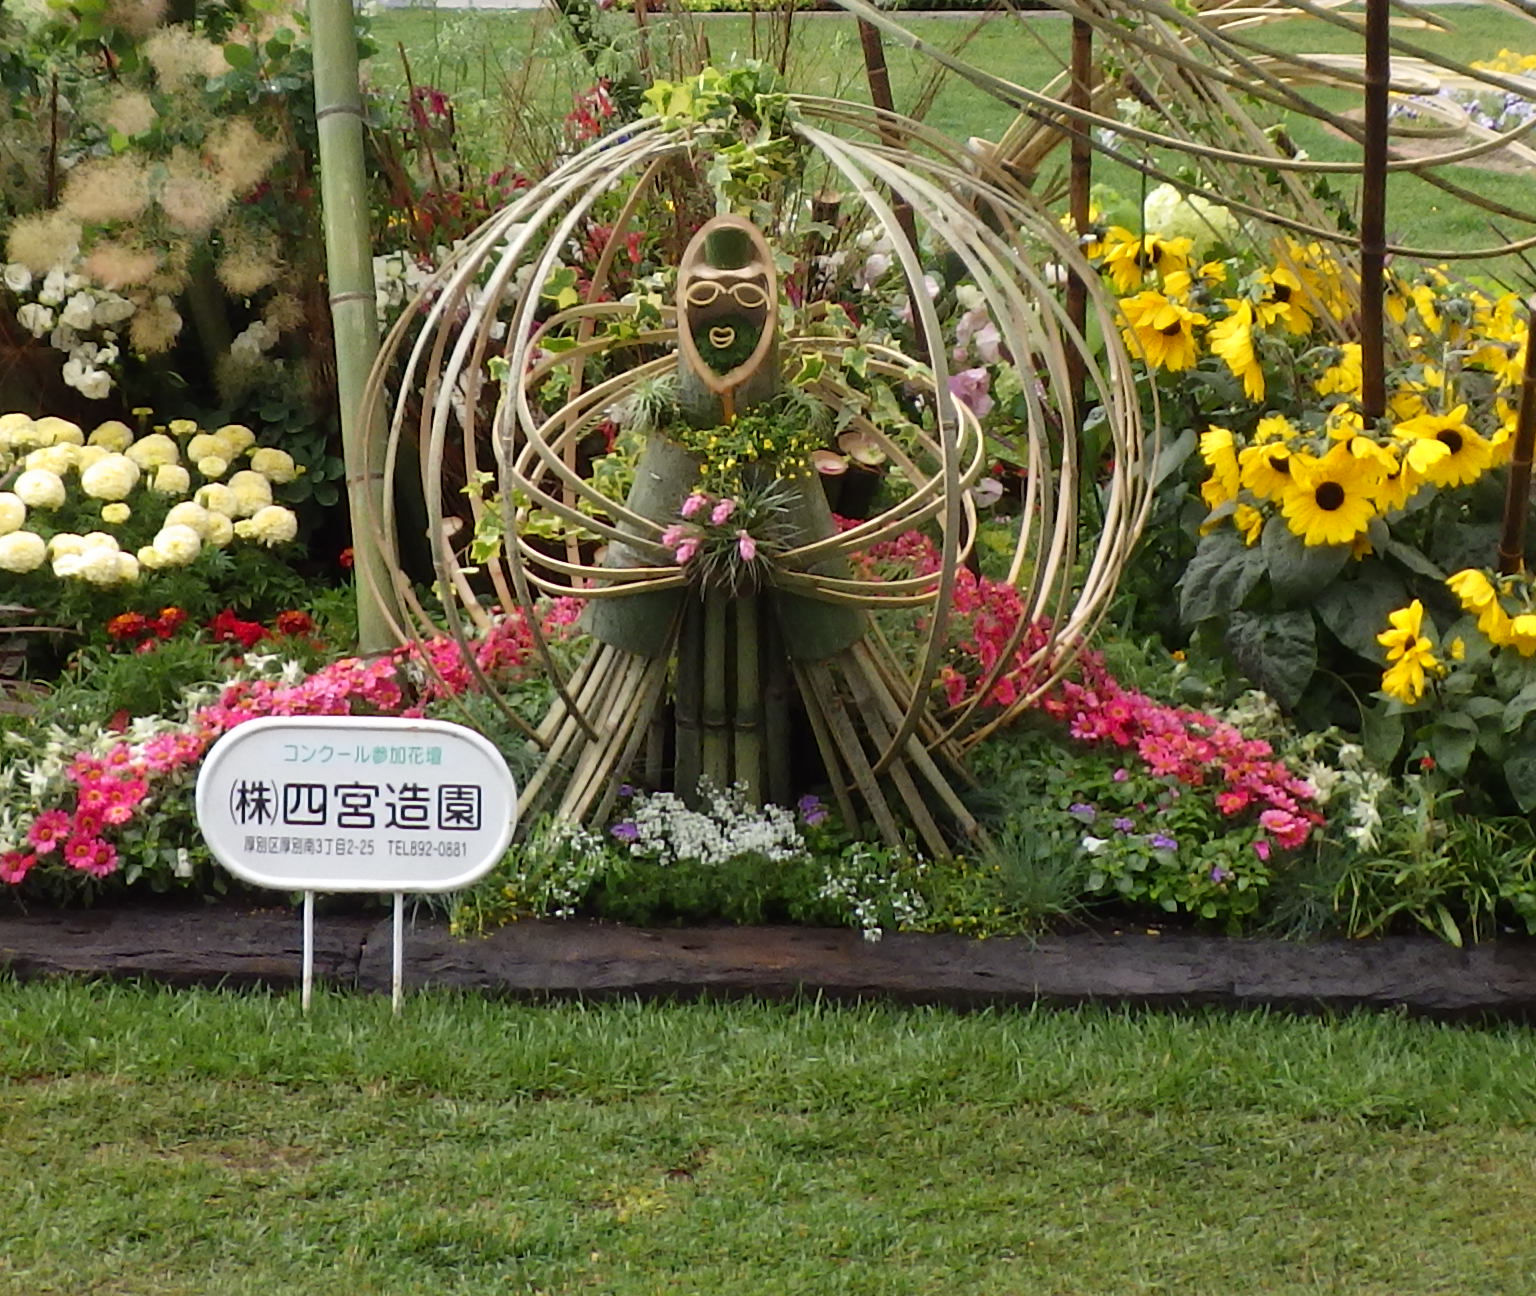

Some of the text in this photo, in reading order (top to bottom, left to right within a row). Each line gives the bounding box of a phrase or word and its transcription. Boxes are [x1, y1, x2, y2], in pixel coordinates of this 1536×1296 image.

[283, 744, 442, 765] コンクール参加花壇
[229, 778, 482, 831] (株)四宮造園
